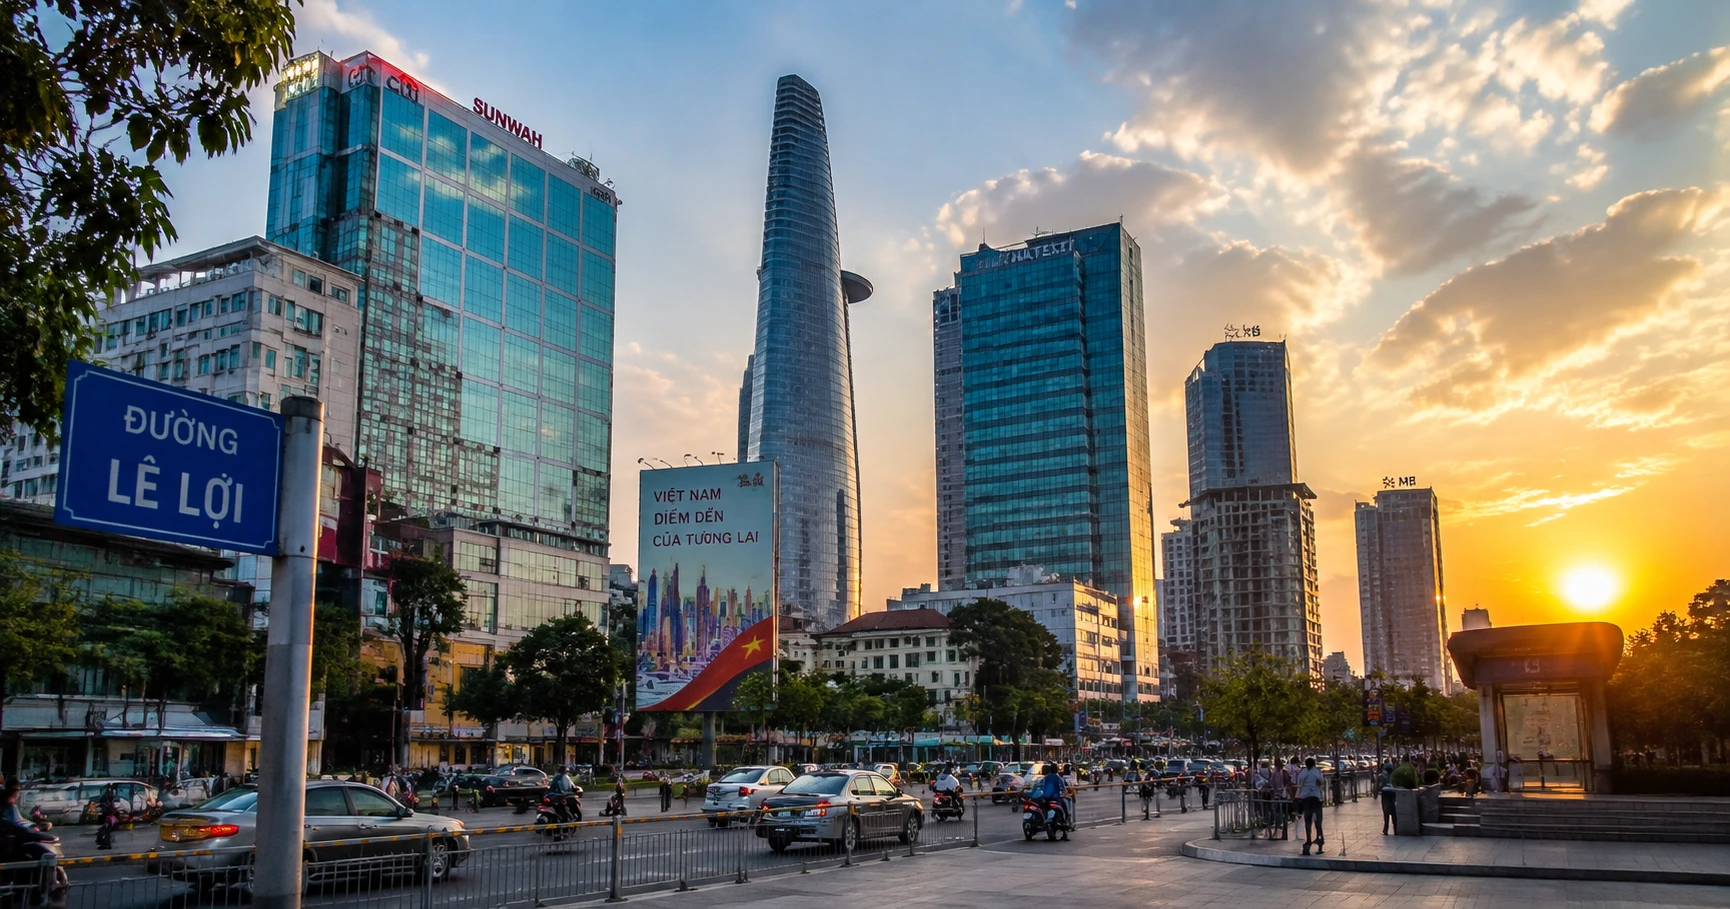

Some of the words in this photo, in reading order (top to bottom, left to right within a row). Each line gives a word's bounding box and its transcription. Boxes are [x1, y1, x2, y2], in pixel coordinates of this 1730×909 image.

[473, 97, 542, 149] SUNWAH
[124, 405, 239, 455] ĐƯỜNG
[107, 455, 160, 509] LÊ
[690, 488, 721, 501] NAM
[1398, 476, 1416, 487] MB
[737, 531, 758, 544] LAI
